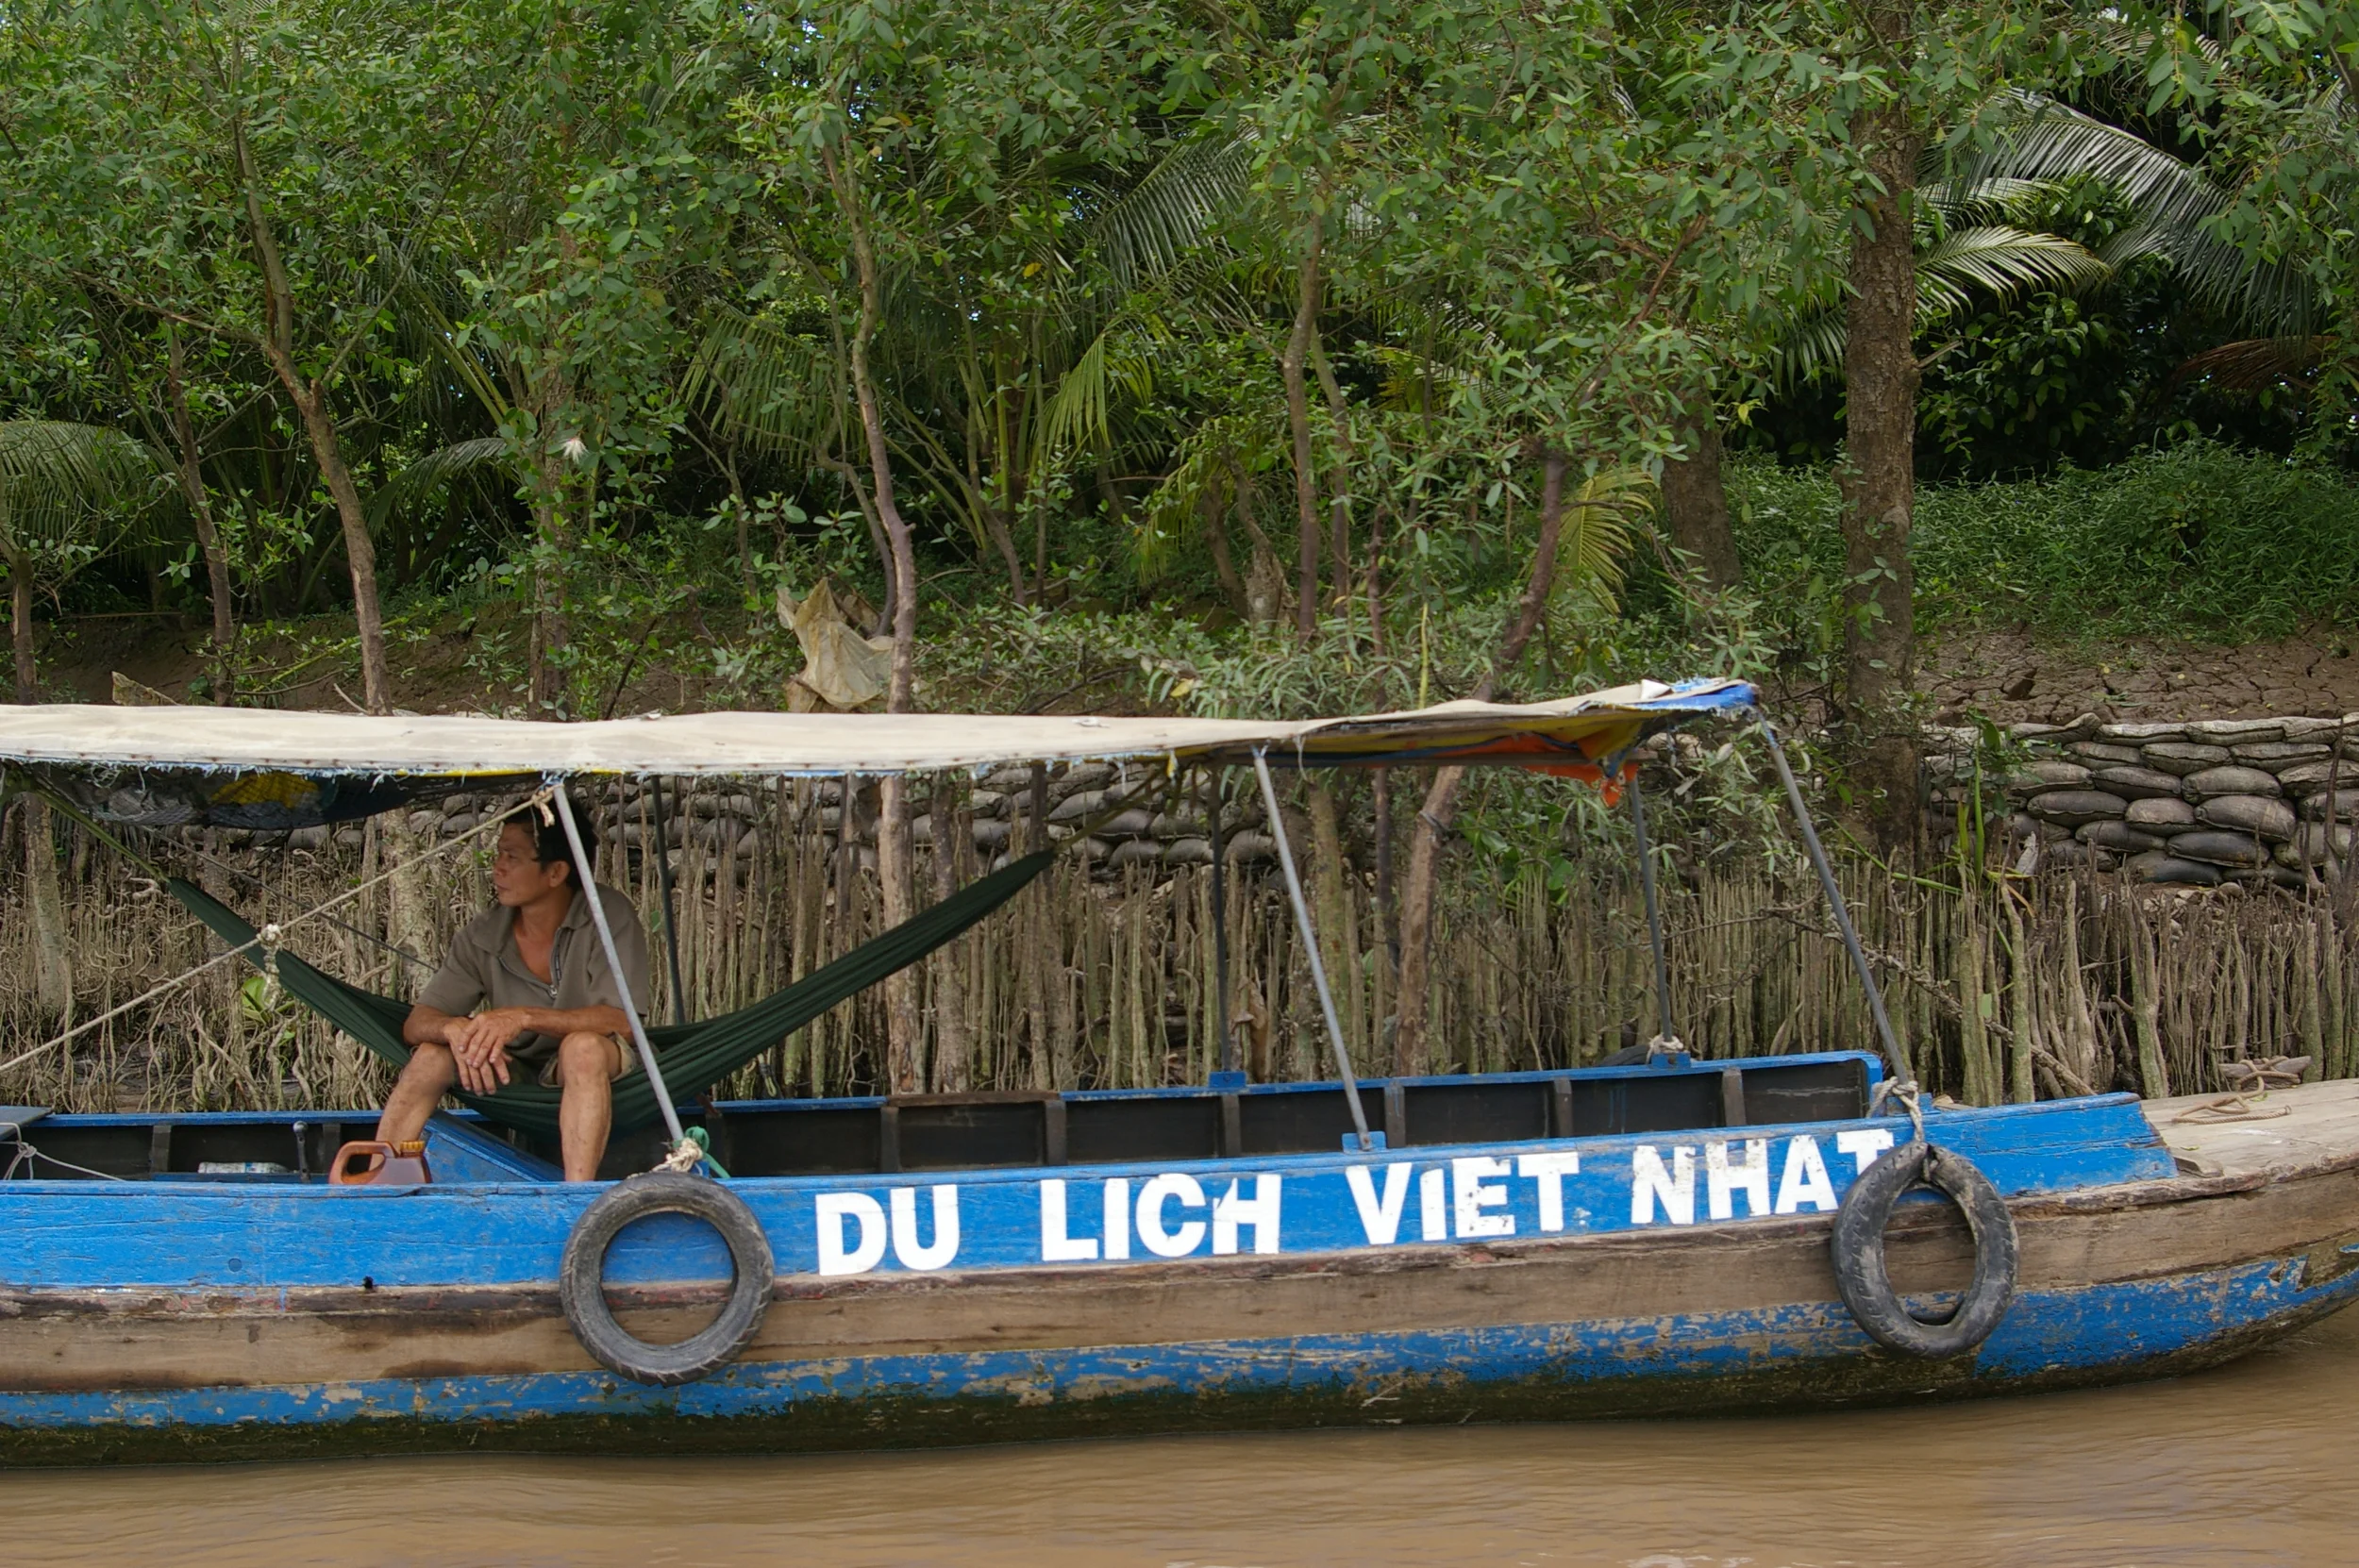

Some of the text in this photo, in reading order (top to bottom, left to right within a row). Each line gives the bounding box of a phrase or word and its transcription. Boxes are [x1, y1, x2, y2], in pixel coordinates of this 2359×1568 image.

[815, 1128, 1895, 1276] DU LICH VIET NHAT
